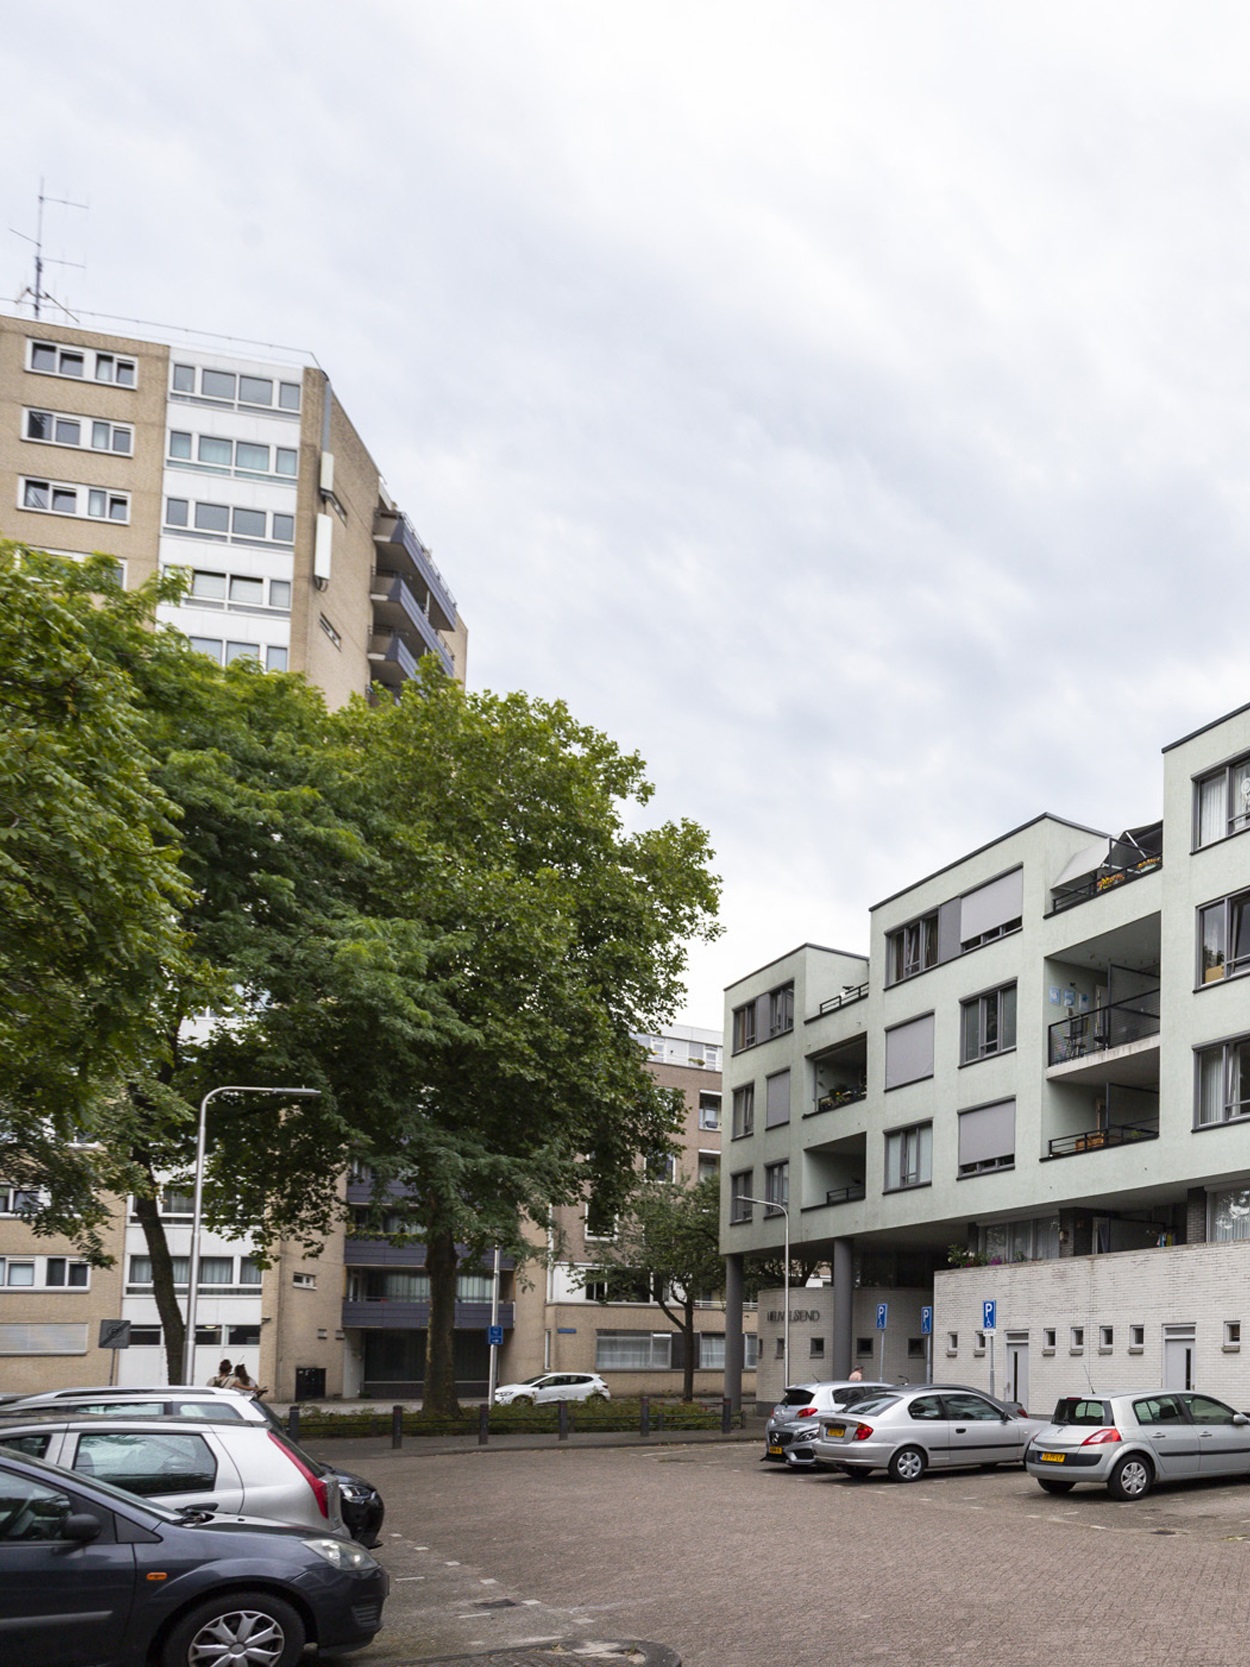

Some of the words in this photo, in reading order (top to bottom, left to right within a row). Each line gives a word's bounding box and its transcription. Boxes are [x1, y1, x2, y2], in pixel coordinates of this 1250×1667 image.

[878, 1306, 885, 1319] P
[923, 1309, 929, 1322] P
[985, 1303, 993, 1318] P
